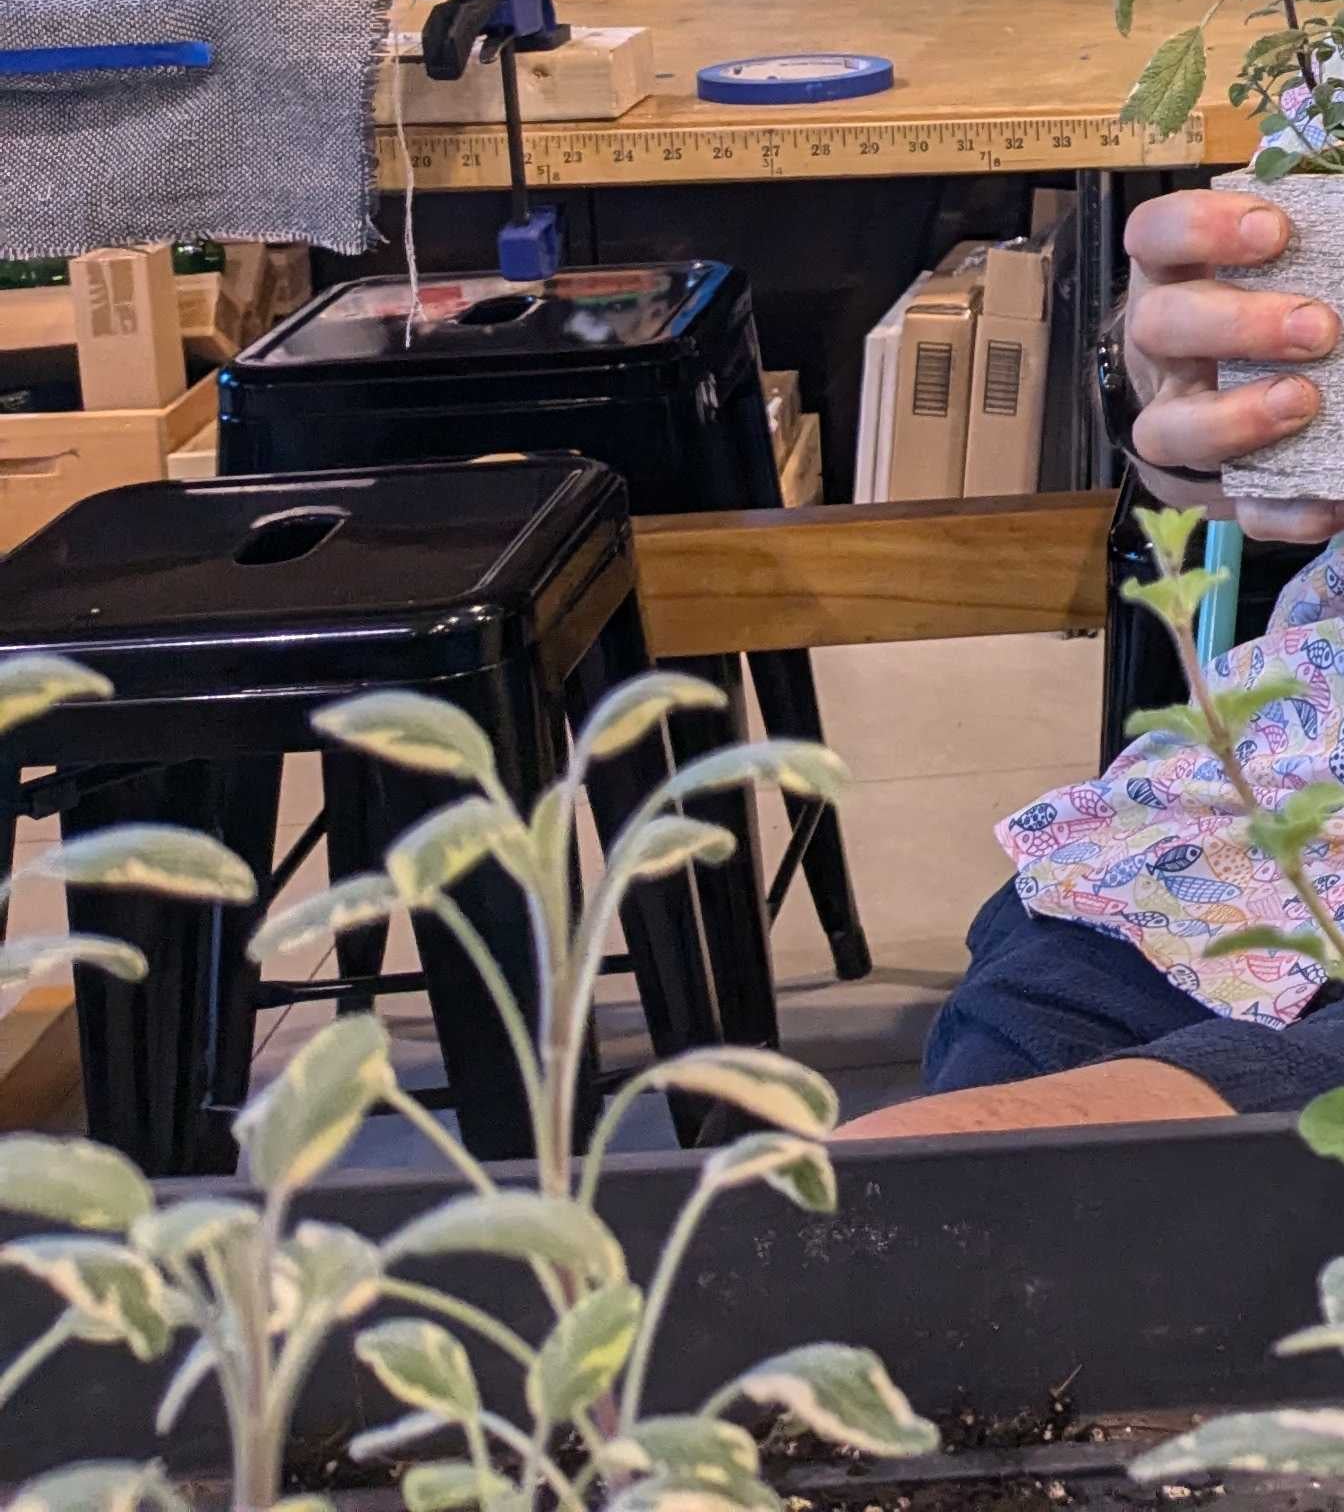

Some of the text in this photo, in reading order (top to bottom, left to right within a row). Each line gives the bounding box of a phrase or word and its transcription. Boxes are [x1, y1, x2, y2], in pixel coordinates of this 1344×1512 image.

[461, 154, 482, 167] 21
[563, 151, 582, 163] 23
[613, 150, 634, 162] 24
[663, 148, 682, 160] 25
[712, 147, 733, 159] 26
[761, 145, 781, 158] 27
[811, 144, 831, 157] 28
[859, 142, 880, 155] 29
[908, 141, 929, 153] 30
[957, 139, 975, 151] 31
[1005, 138, 1024, 150] 32
[1052, 136, 1072, 148] 33
[1100, 134, 1120, 146] 34
